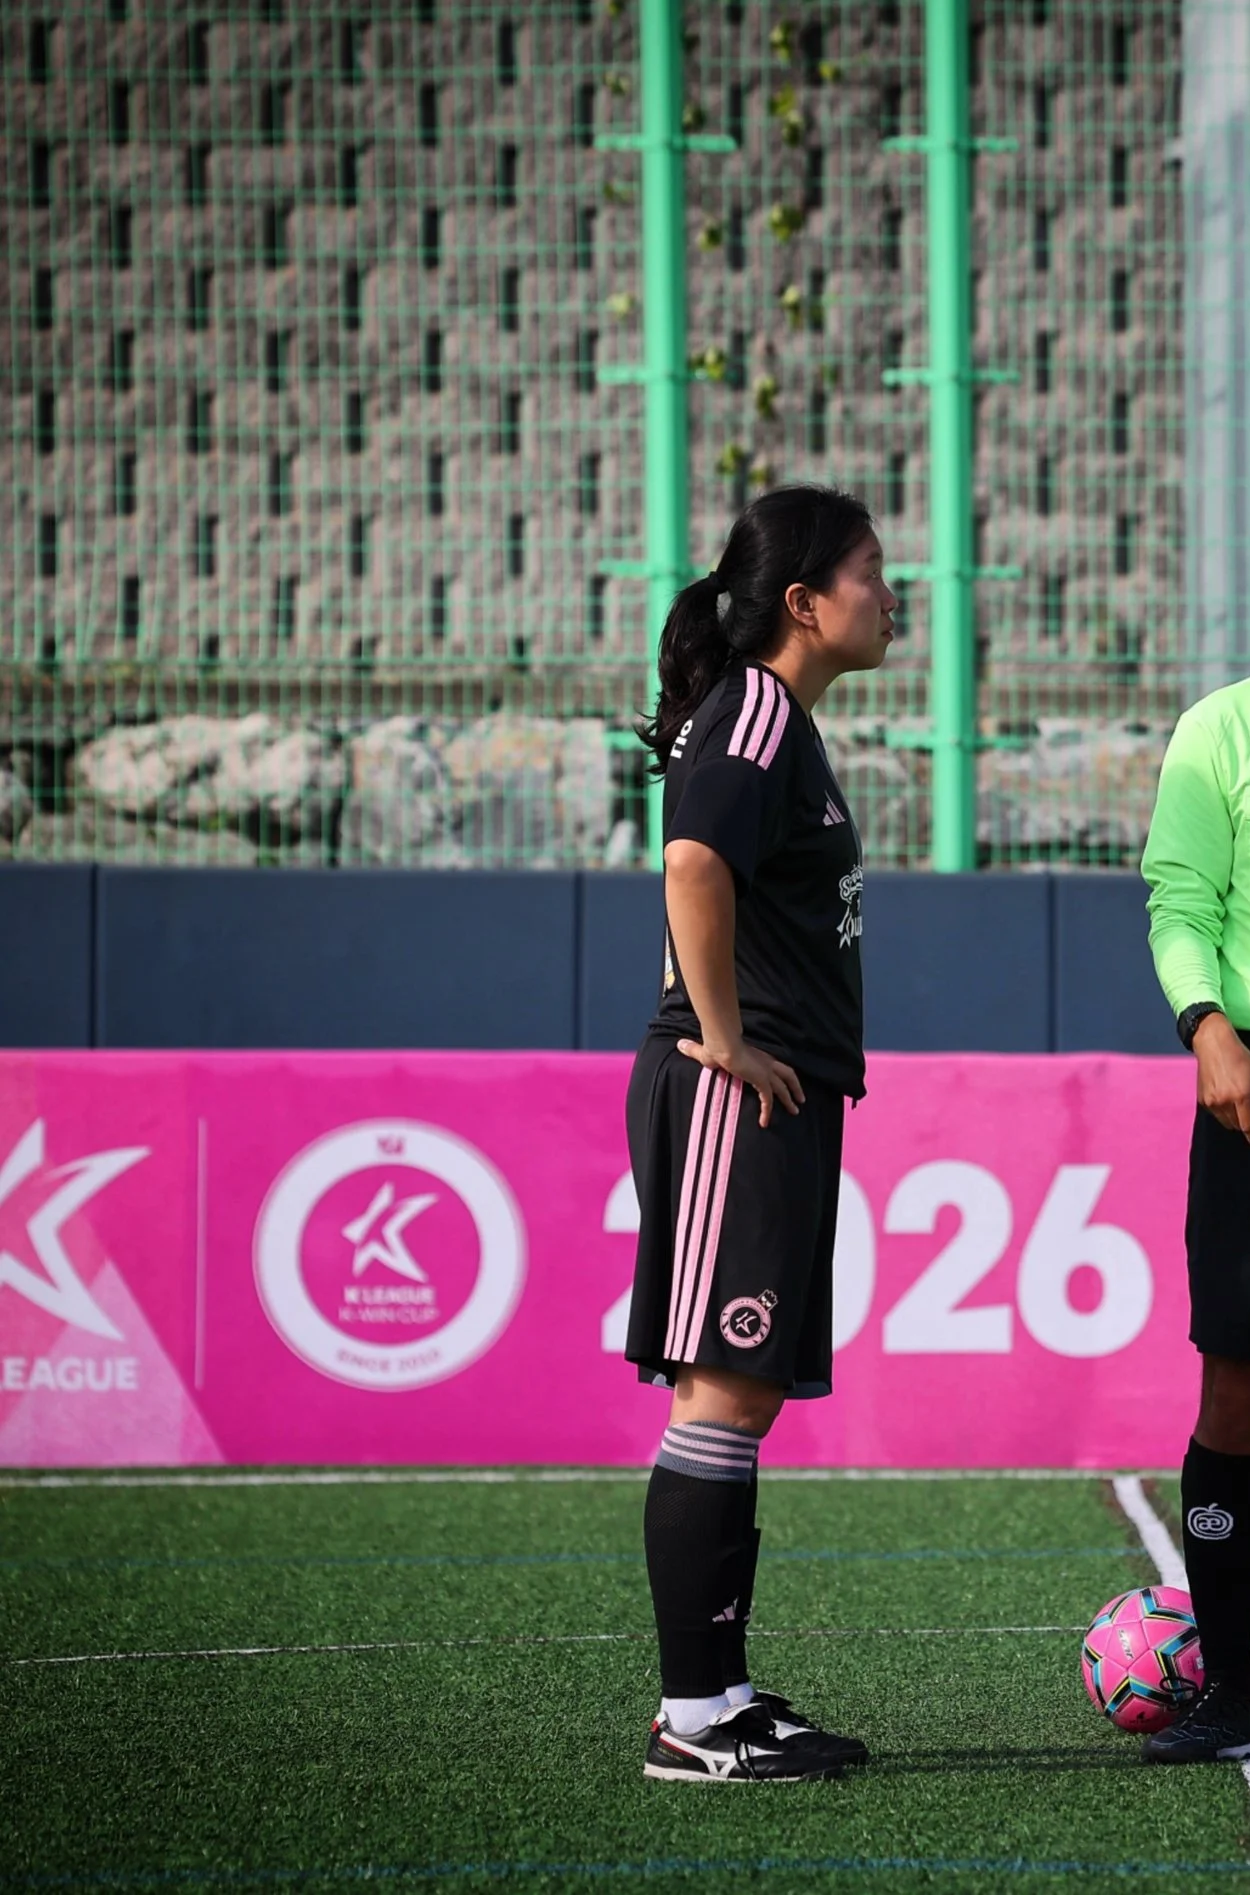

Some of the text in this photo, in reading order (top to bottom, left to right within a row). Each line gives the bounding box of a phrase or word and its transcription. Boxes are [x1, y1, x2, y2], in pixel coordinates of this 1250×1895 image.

[361, 1285, 436, 1305] LEAGUE
[396, 1306, 441, 1324] CUP
[0, 1356, 140, 1393] EAGUE
